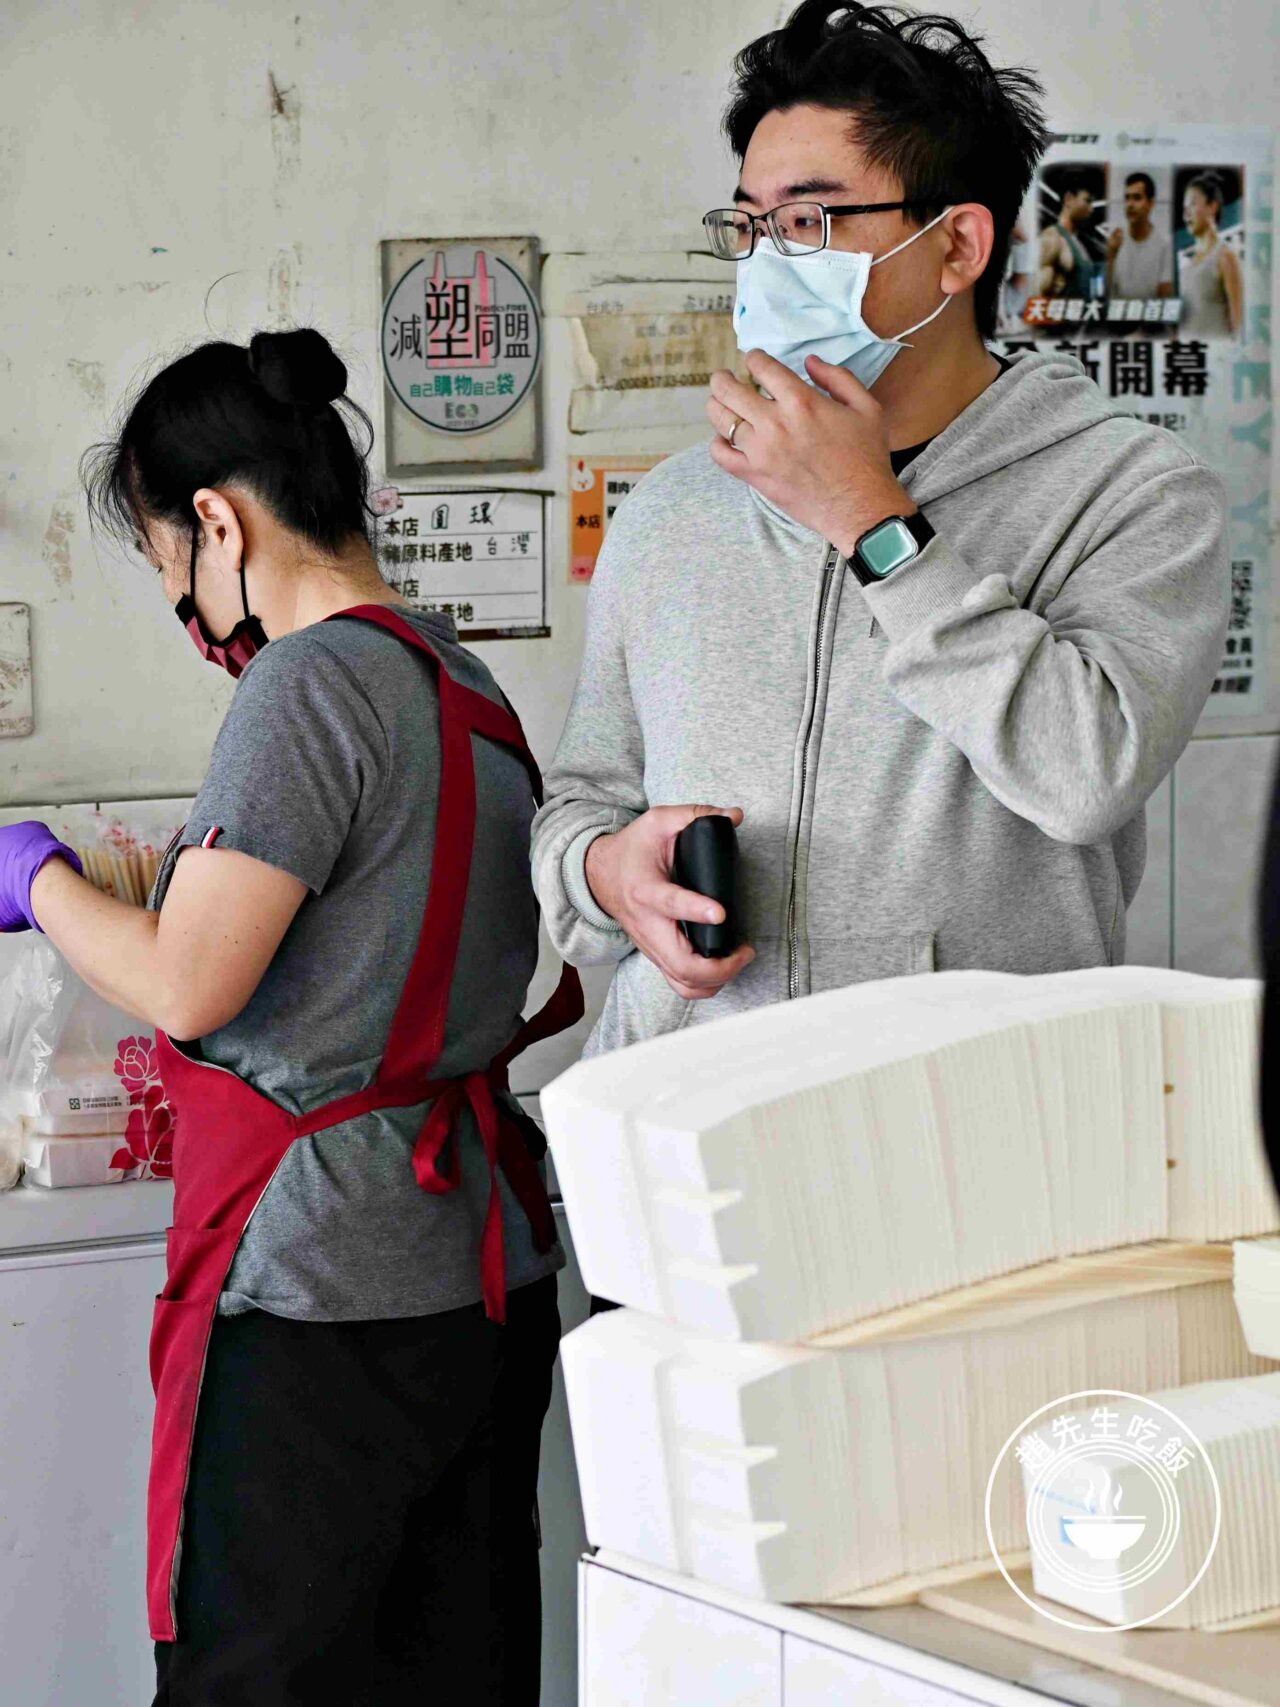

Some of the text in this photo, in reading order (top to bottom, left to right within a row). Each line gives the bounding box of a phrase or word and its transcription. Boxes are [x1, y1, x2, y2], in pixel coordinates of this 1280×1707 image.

[390, 281, 532, 361] 減塑同盟
[409, 373, 514, 398] 自己購物自己袋
[384, 517, 419, 537] 本店
[576, 515, 601, 529] 本店
